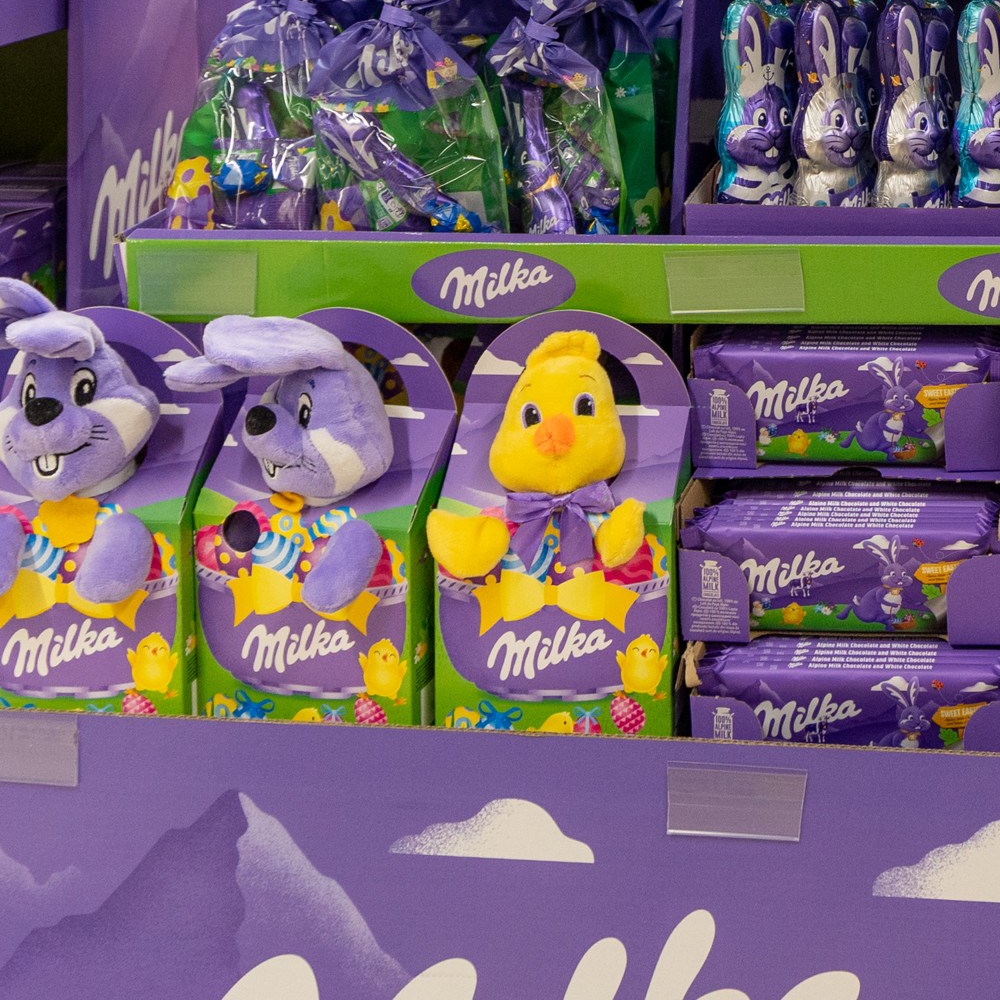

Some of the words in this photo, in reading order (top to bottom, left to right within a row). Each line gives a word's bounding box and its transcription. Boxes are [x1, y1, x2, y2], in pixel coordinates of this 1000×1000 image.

[440, 258, 553, 309] Milka
[747, 373, 849, 419] Milka
[740, 551, 845, 594] Milka
[1, 618, 123, 678] Milka
[241, 620, 356, 674] Milka
[487, 621, 612, 681] Milka
[754, 693, 862, 740] Milka
